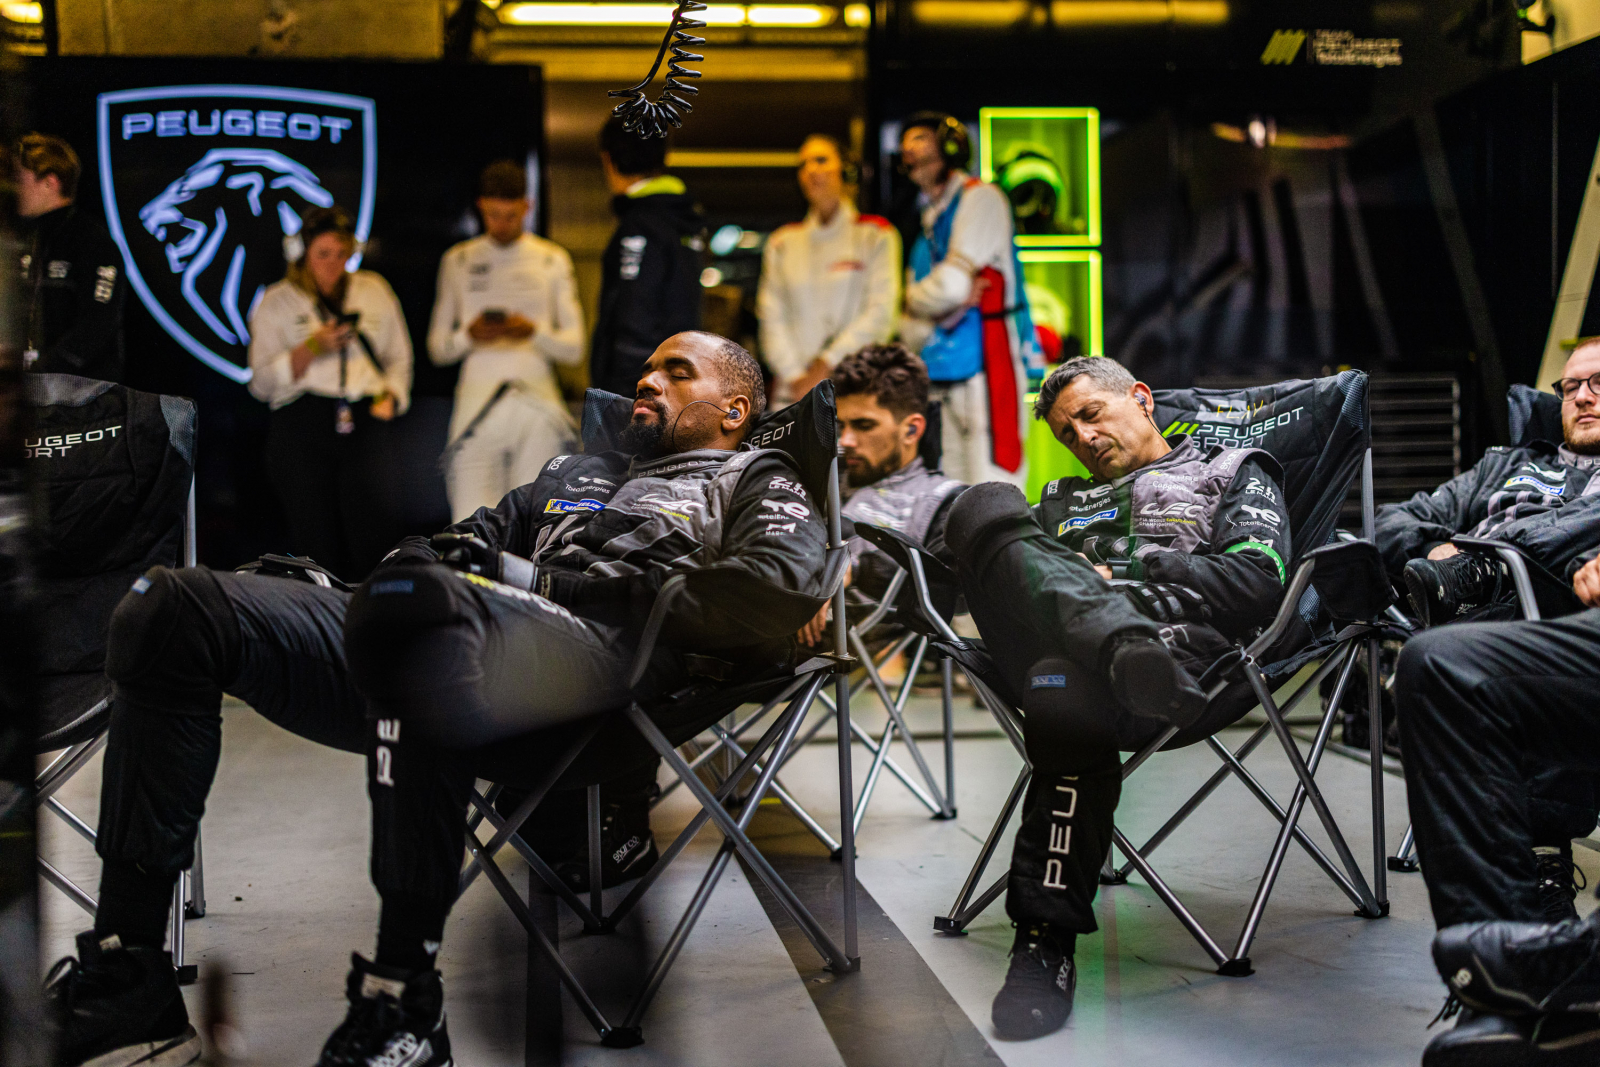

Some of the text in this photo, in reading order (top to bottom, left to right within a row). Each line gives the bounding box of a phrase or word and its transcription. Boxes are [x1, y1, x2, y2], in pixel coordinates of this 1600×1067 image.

[122, 110, 353, 143] PEUGEOT
[25, 425, 122, 447] UGEOT
[750, 421, 796, 447] GEOT
[1196, 406, 1304, 440] PEUGEOT
[1192, 432, 1268, 450] SPORT
[1042, 775, 1080, 890] PEU
